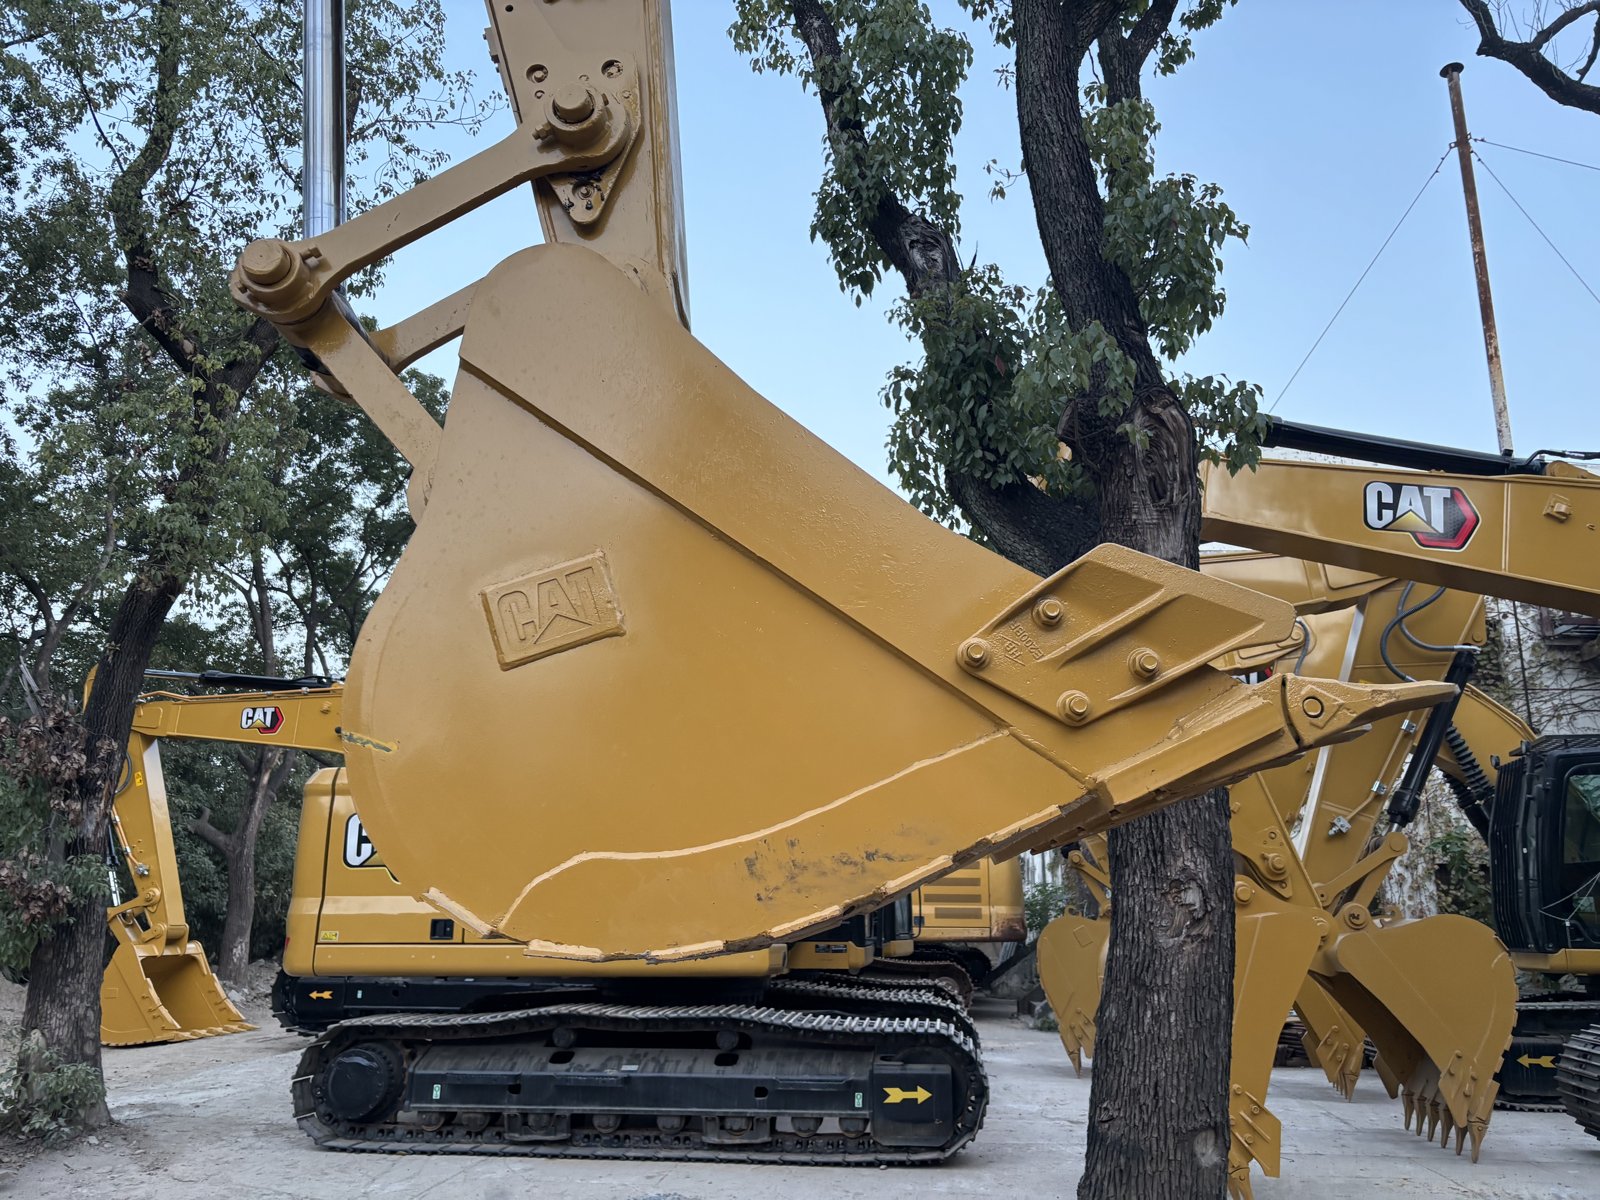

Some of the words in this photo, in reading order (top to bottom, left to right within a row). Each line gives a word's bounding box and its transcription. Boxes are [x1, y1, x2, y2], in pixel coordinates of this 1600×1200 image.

[1366, 482, 1451, 533] CAT
[498, 566, 601, 646] CAT
[241, 707, 275, 729] CAT
